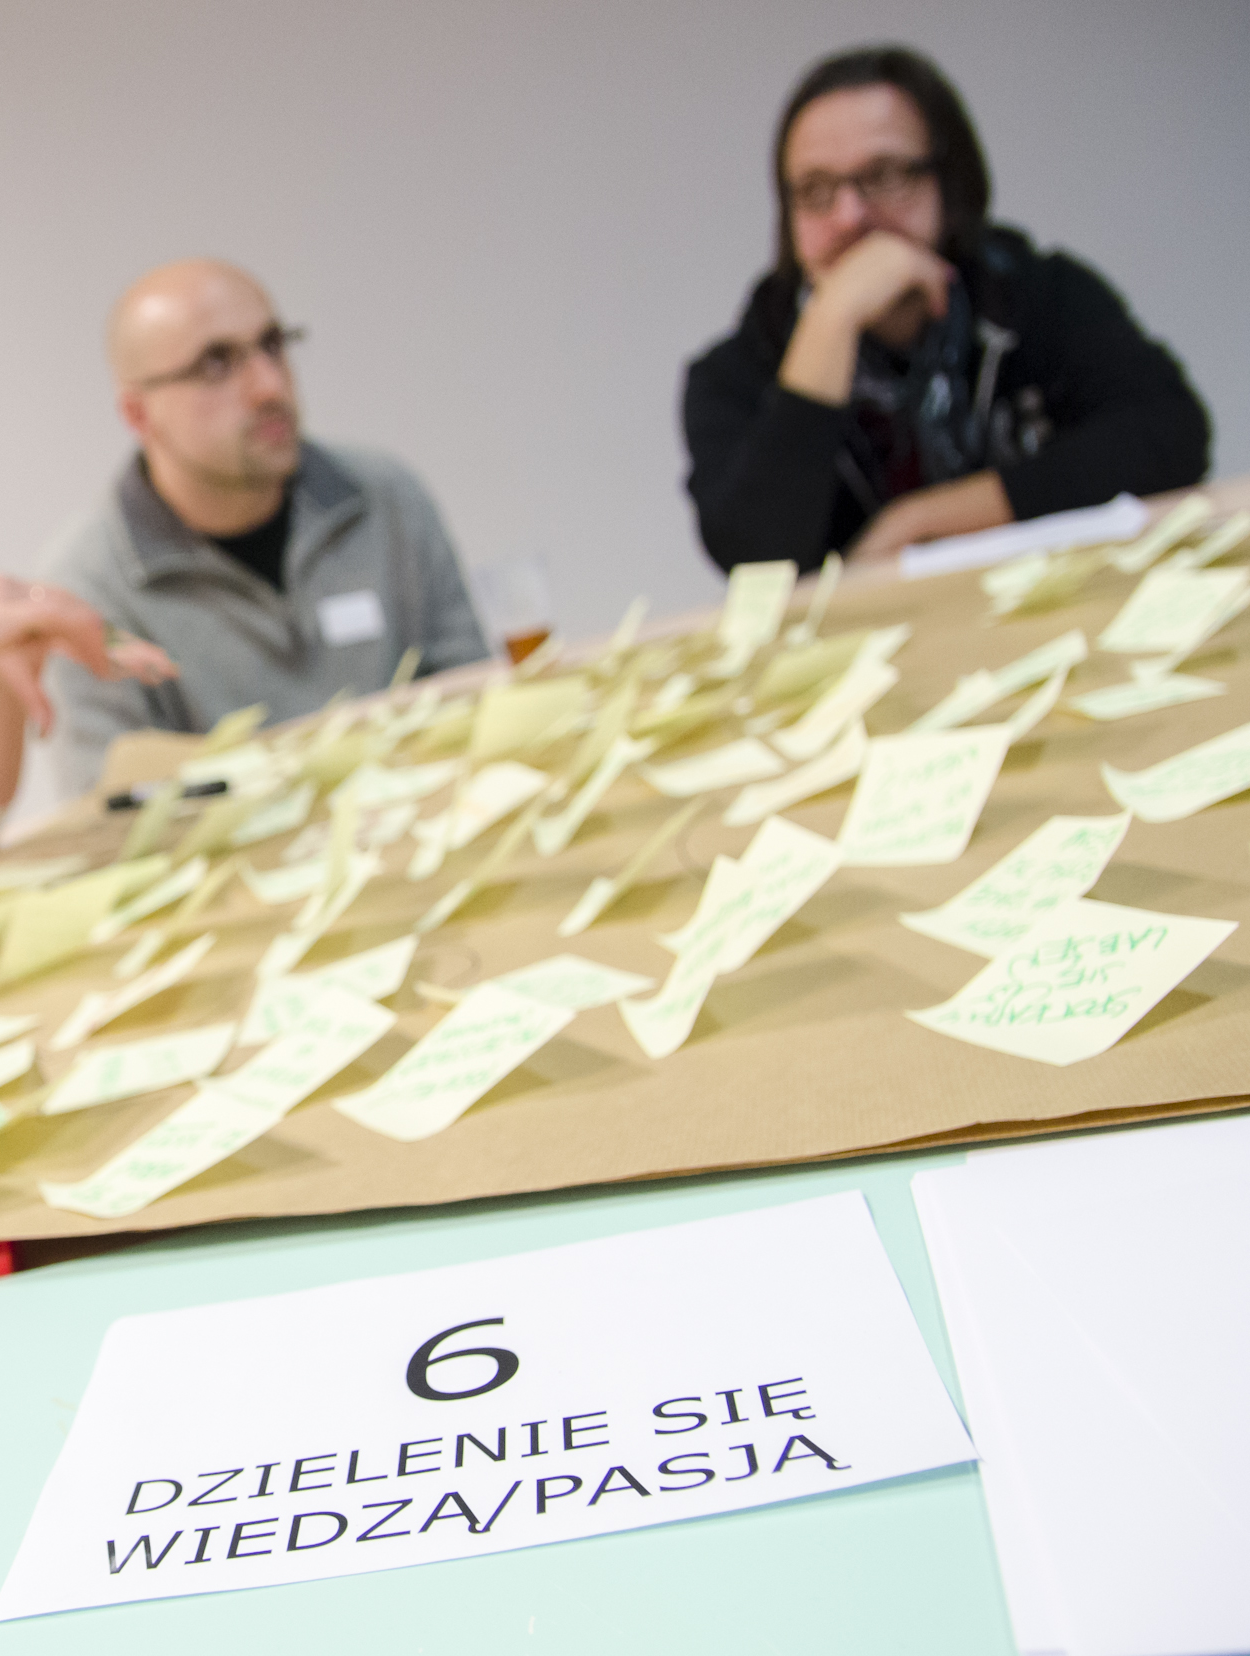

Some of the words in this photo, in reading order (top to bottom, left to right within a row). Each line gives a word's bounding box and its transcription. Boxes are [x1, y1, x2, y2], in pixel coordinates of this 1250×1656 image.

[404, 1316, 521, 1402] 6
[105, 1433, 853, 1576] WIEDZĄ/PASJĄ
[124, 1409, 611, 1516] DZIELENIE
[651, 1376, 817, 1436] SIĘ
